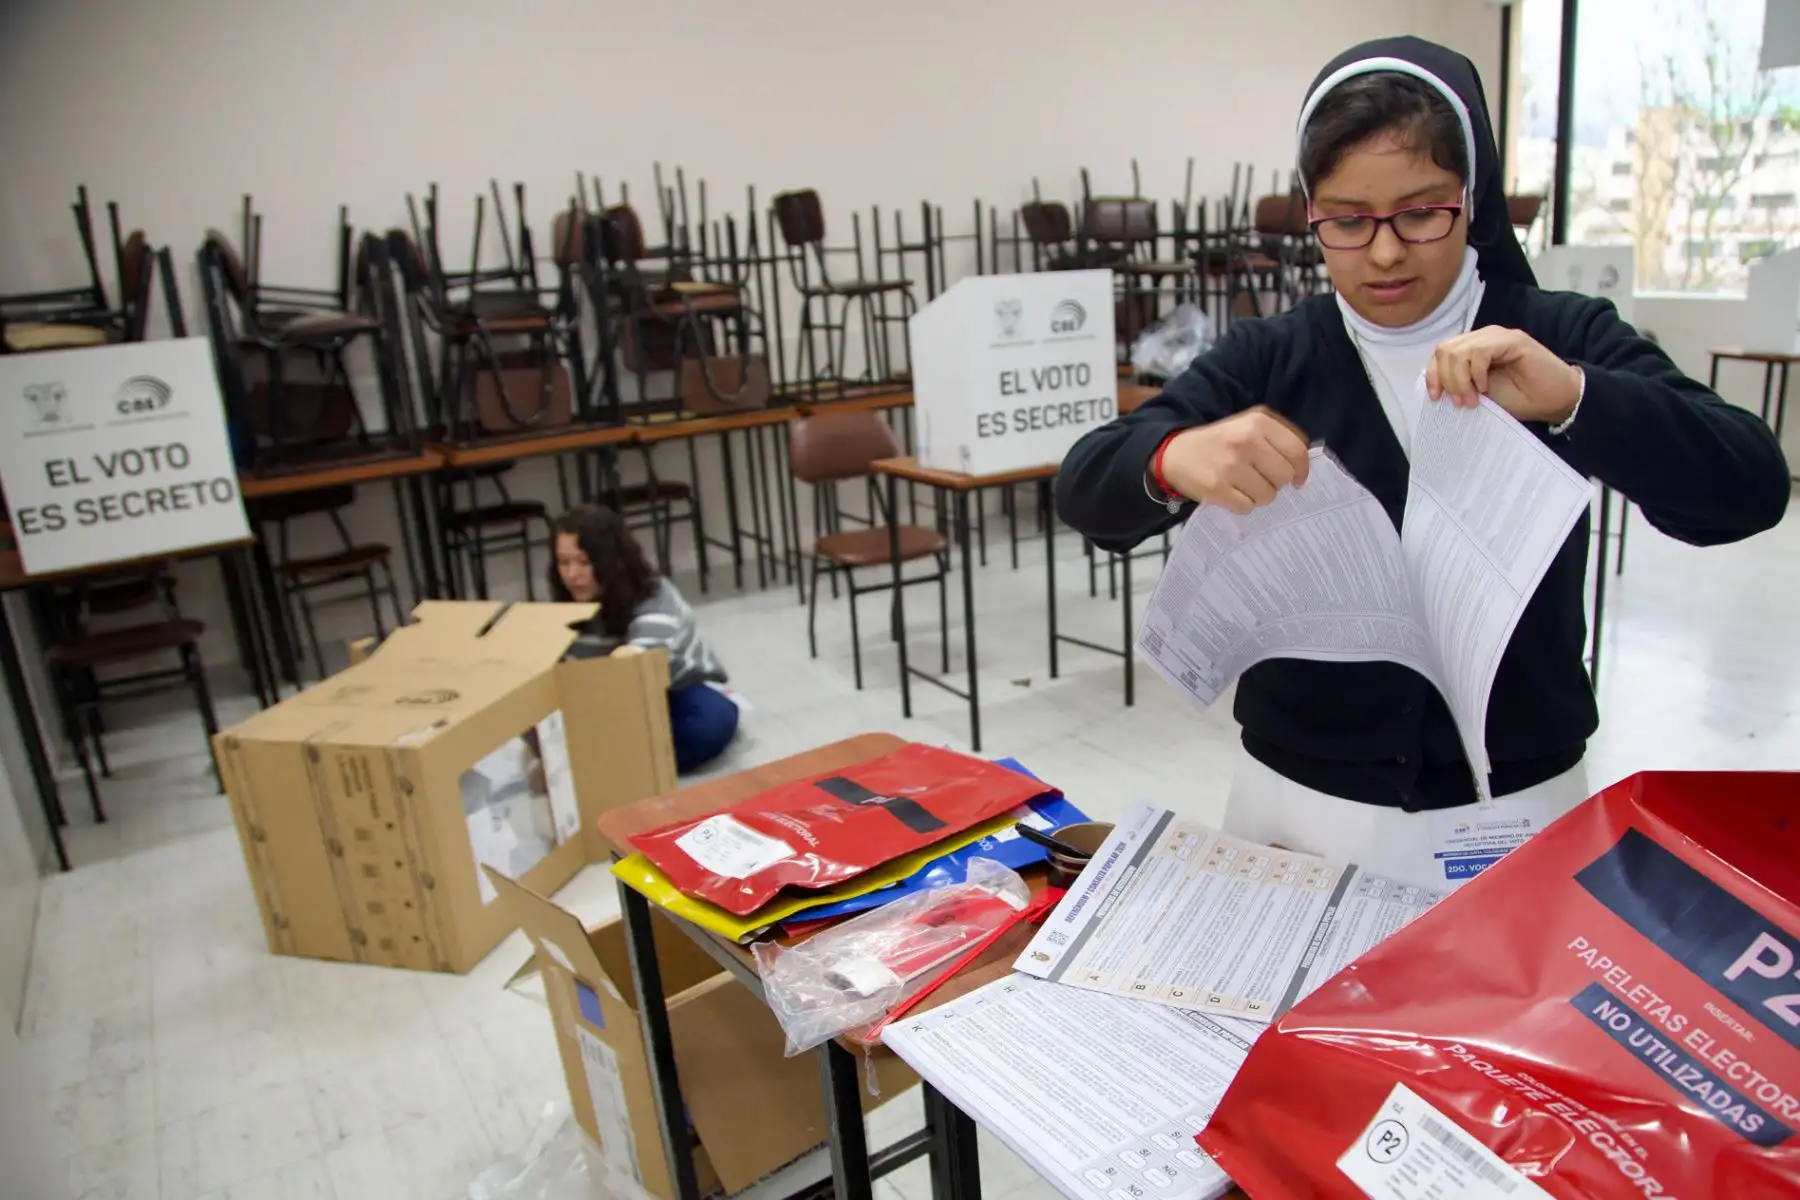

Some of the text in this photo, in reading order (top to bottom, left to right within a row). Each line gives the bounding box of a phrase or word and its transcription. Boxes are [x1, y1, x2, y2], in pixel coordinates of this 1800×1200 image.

[1000, 363, 1090, 396] EL VOTO
[977, 397, 1113, 438] ES SECRETO
[44, 442, 190, 487] EL VOTO
[17, 477, 233, 535] ES SECRETO
[1469, 863, 1492, 872] VOC
[1004, 985, 1015, 993] H
[912, 1024, 923, 1032] K
[1567, 936, 1800, 1120] PAPELETAS ELECTOR
[1592, 1000, 1765, 1132] NO UTILIZADAS
[1442, 1044, 1552, 1101] PAQUETE
[1544, 1102, 1678, 1200] ELECTOR
[1376, 1130, 1401, 1155] P2
[1162, 1165, 1178, 1177] NO
[1127, 1184, 1143, 1197] NO
